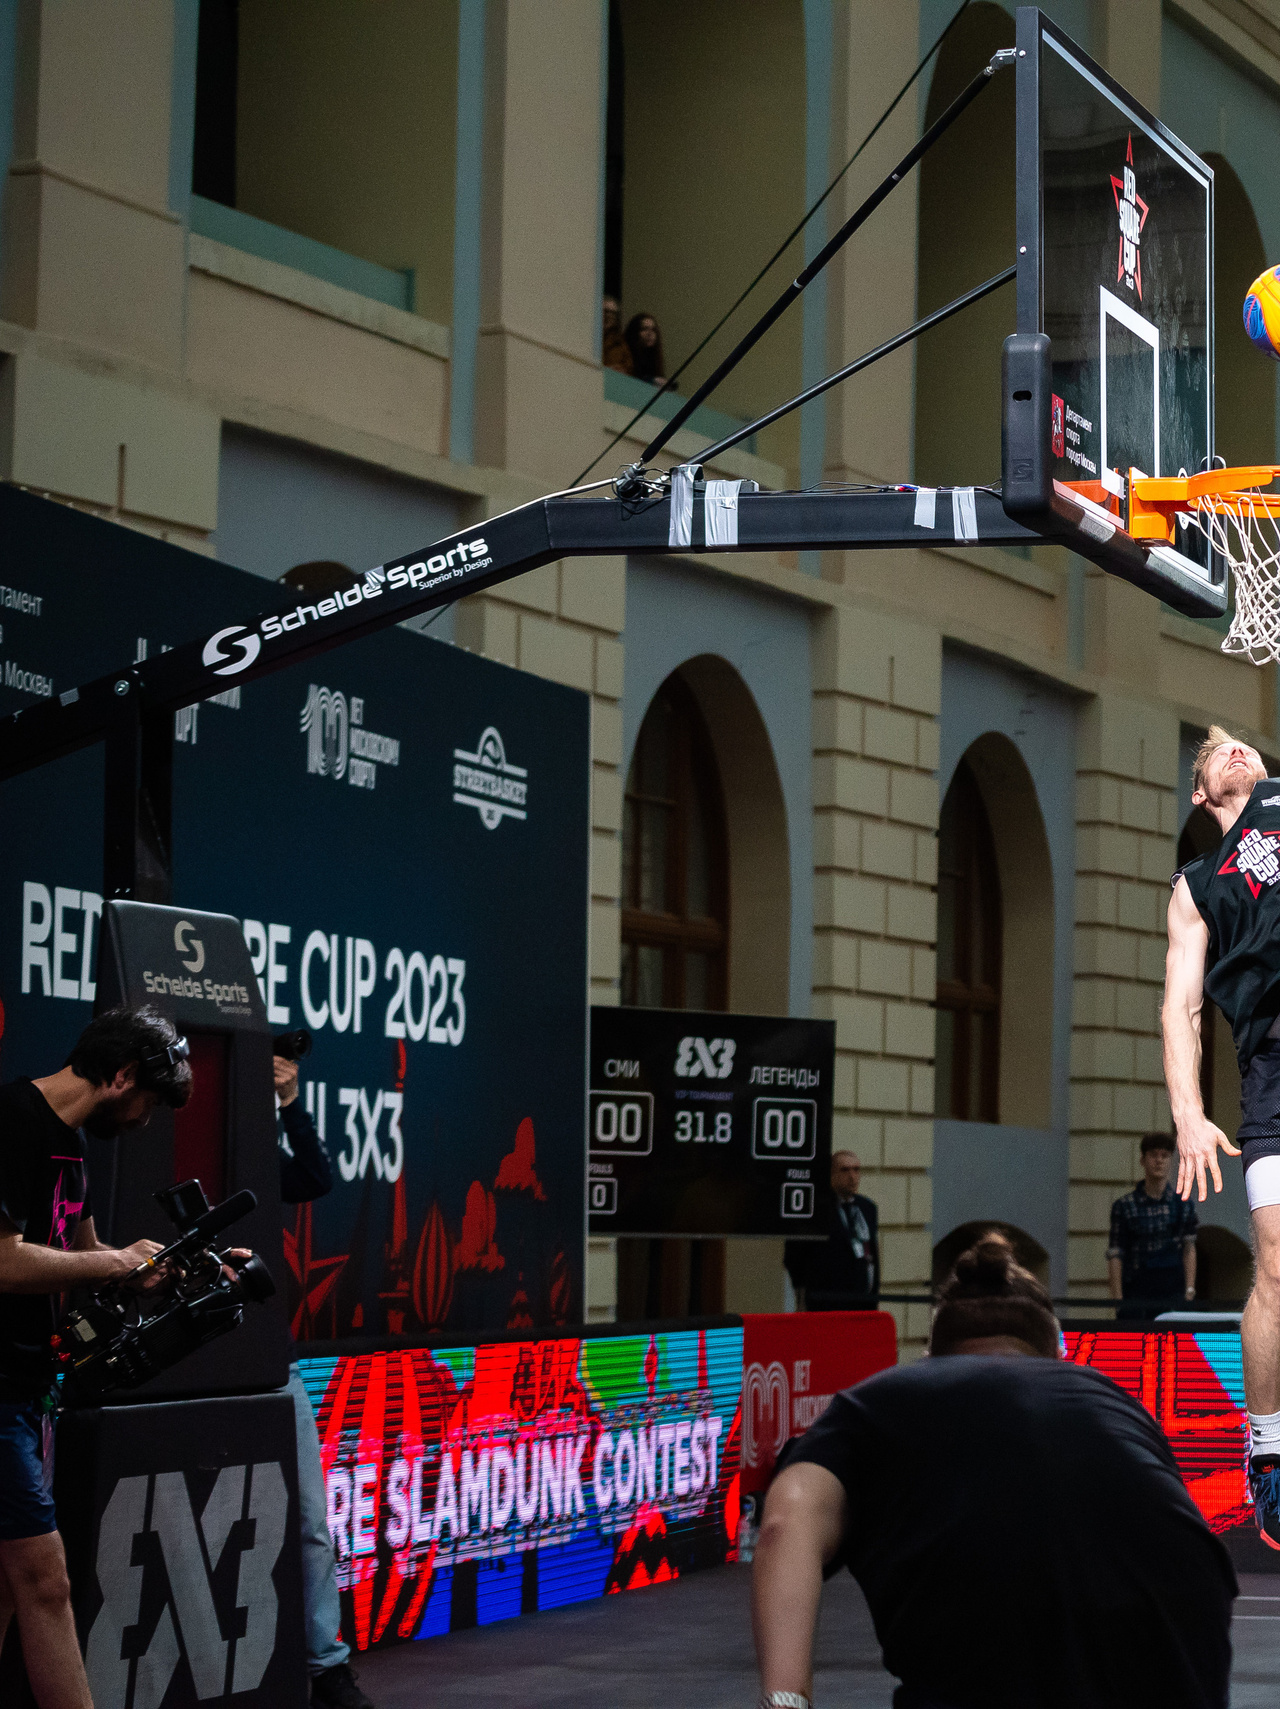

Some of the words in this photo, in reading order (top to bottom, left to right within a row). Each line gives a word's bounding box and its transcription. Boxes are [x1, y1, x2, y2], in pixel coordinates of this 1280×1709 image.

[260, 580, 384, 641] Schelde
[386, 537, 489, 589] Sports
[418, 570, 452, 591] Superior
[452, 565, 464, 578] by
[464, 556, 493, 573] Design
[1236, 828, 1263, 853] RED
[1236, 835, 1280, 874] SQUARE
[1251, 852, 1280, 882] CUP
[142, 970, 204, 999] Schelde
[203, 978, 250, 1008] Sports
[301, 929, 377, 1035] CUP
[384, 947, 466, 1048] 2023
[604, 1058, 640, 1079] СМИ
[749, 1065, 821, 1089] ЛЕГЕНДЫ
[338, 1086, 404, 1184] 3X3
[595, 1101, 643, 1144] 00
[674, 1110, 733, 1144] 31.8
[763, 1108, 806, 1148] 00
[592, 1183, 607, 1208] 0
[791, 1188, 805, 1212] 0
[385, 1434, 588, 1549] SLAMDUNK
[592, 1416, 723, 1514] CONTEST
